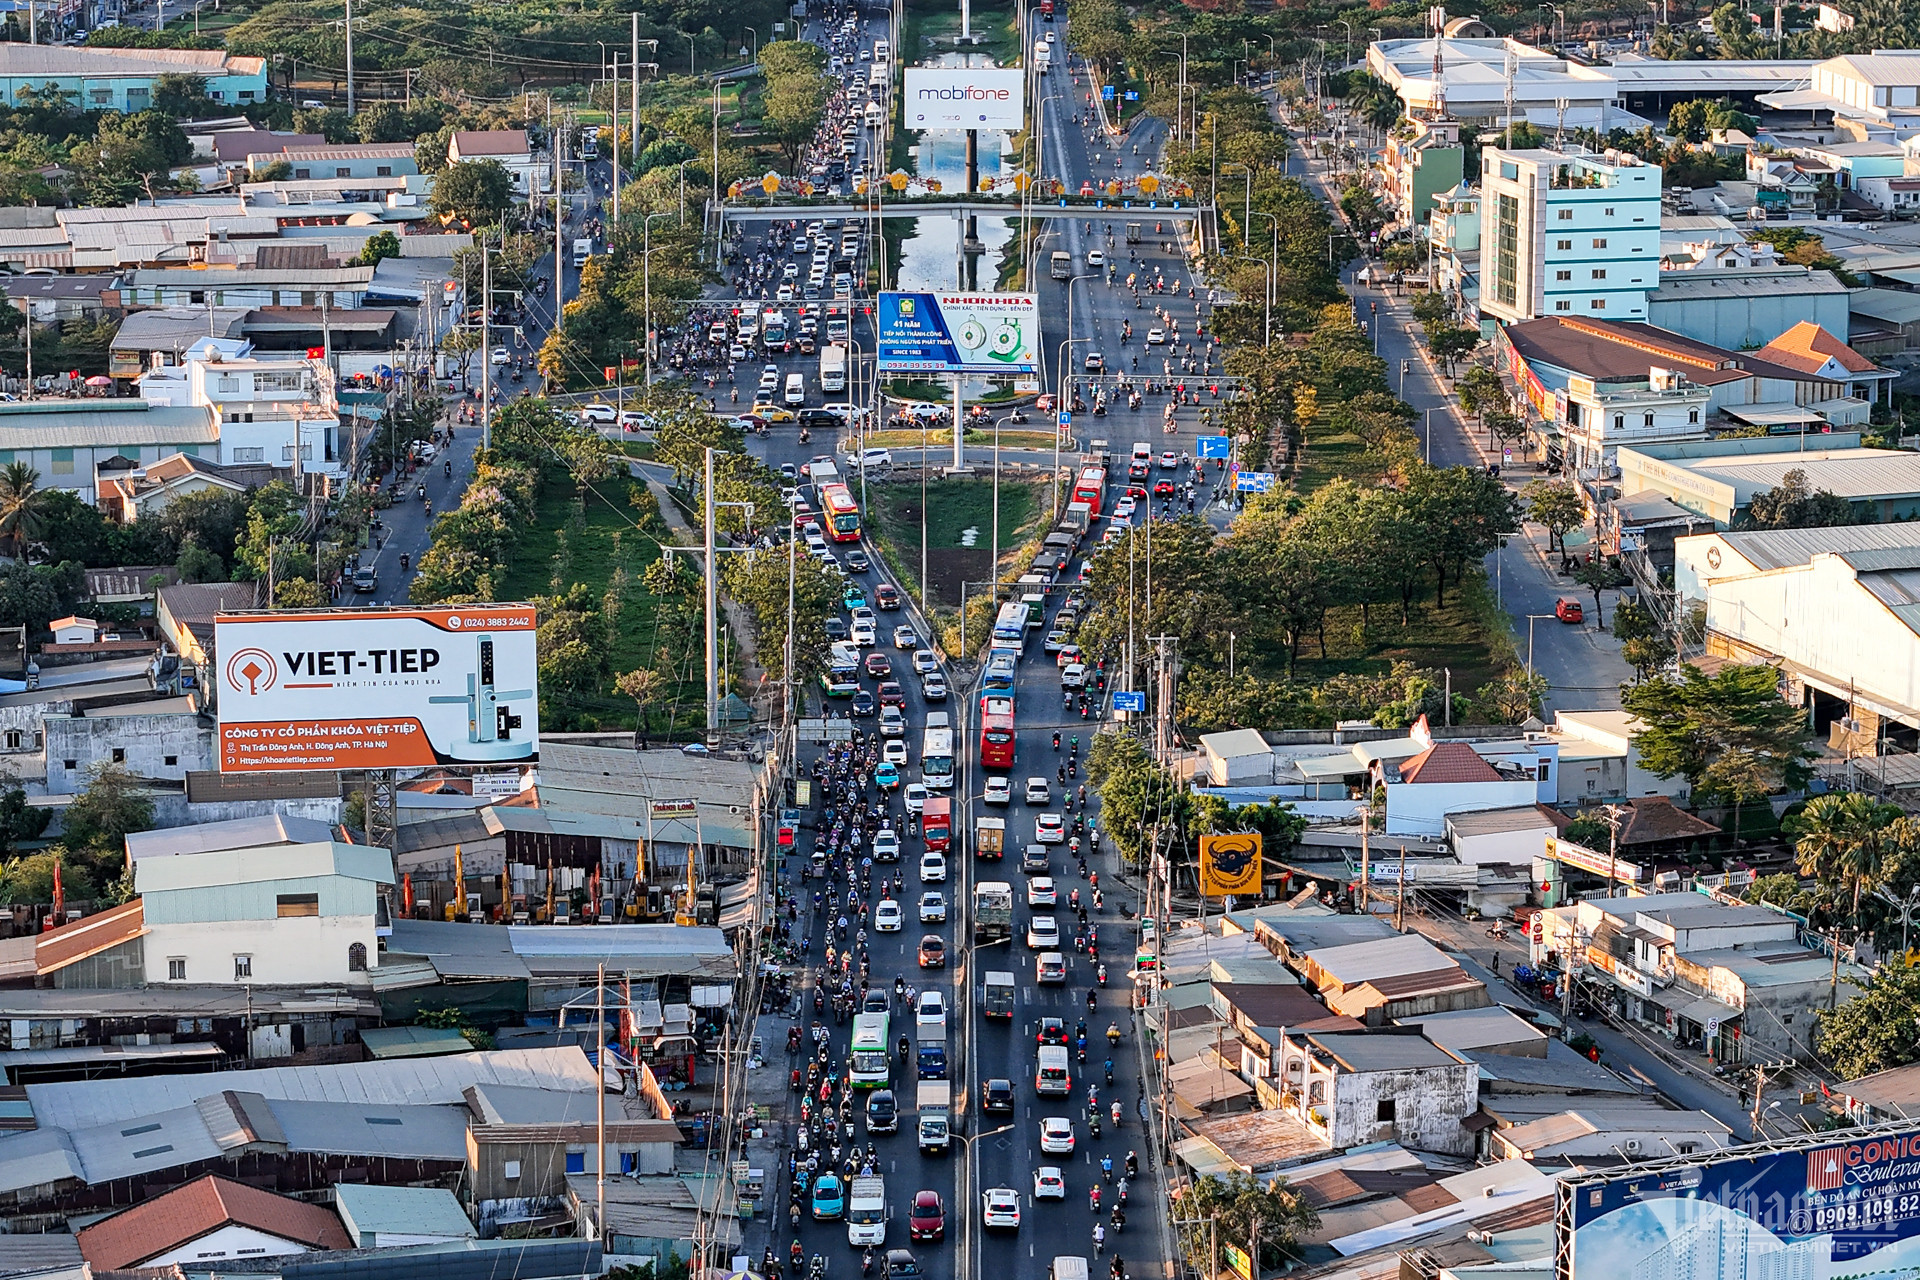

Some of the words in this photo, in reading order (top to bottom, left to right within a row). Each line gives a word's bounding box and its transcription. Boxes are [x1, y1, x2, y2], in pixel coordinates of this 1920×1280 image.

[919, 85, 1010, 100] mobifone
[893, 320, 903, 328] 41
[904, 320, 921, 328] NĂM
[464, 617, 486, 628] (024)
[486, 617, 507, 626] 3883
[508, 616, 530, 626] 2442
[282, 648, 441, 677] VIET-TIEP
[225, 727, 259, 739] CÔNG
[261, 728, 276, 738] TY
[278, 723, 296, 737] CỔ
[331, 723, 363, 736] KHÓA
[365, 721, 417, 737] VIỆT-TIỆP
[288, 742, 305, 751] Anh,
[334, 741, 351, 750] Anh,
[363, 740, 374, 748] Hà
[375, 740, 388, 749] Nội
[1846, 1190, 1860, 1202] AN
[1862, 1185, 1877, 1198] CƯ
[1877, 1181, 1907, 1196] HOÀN
[1816, 1194, 1919, 1227] 0909.109.82
